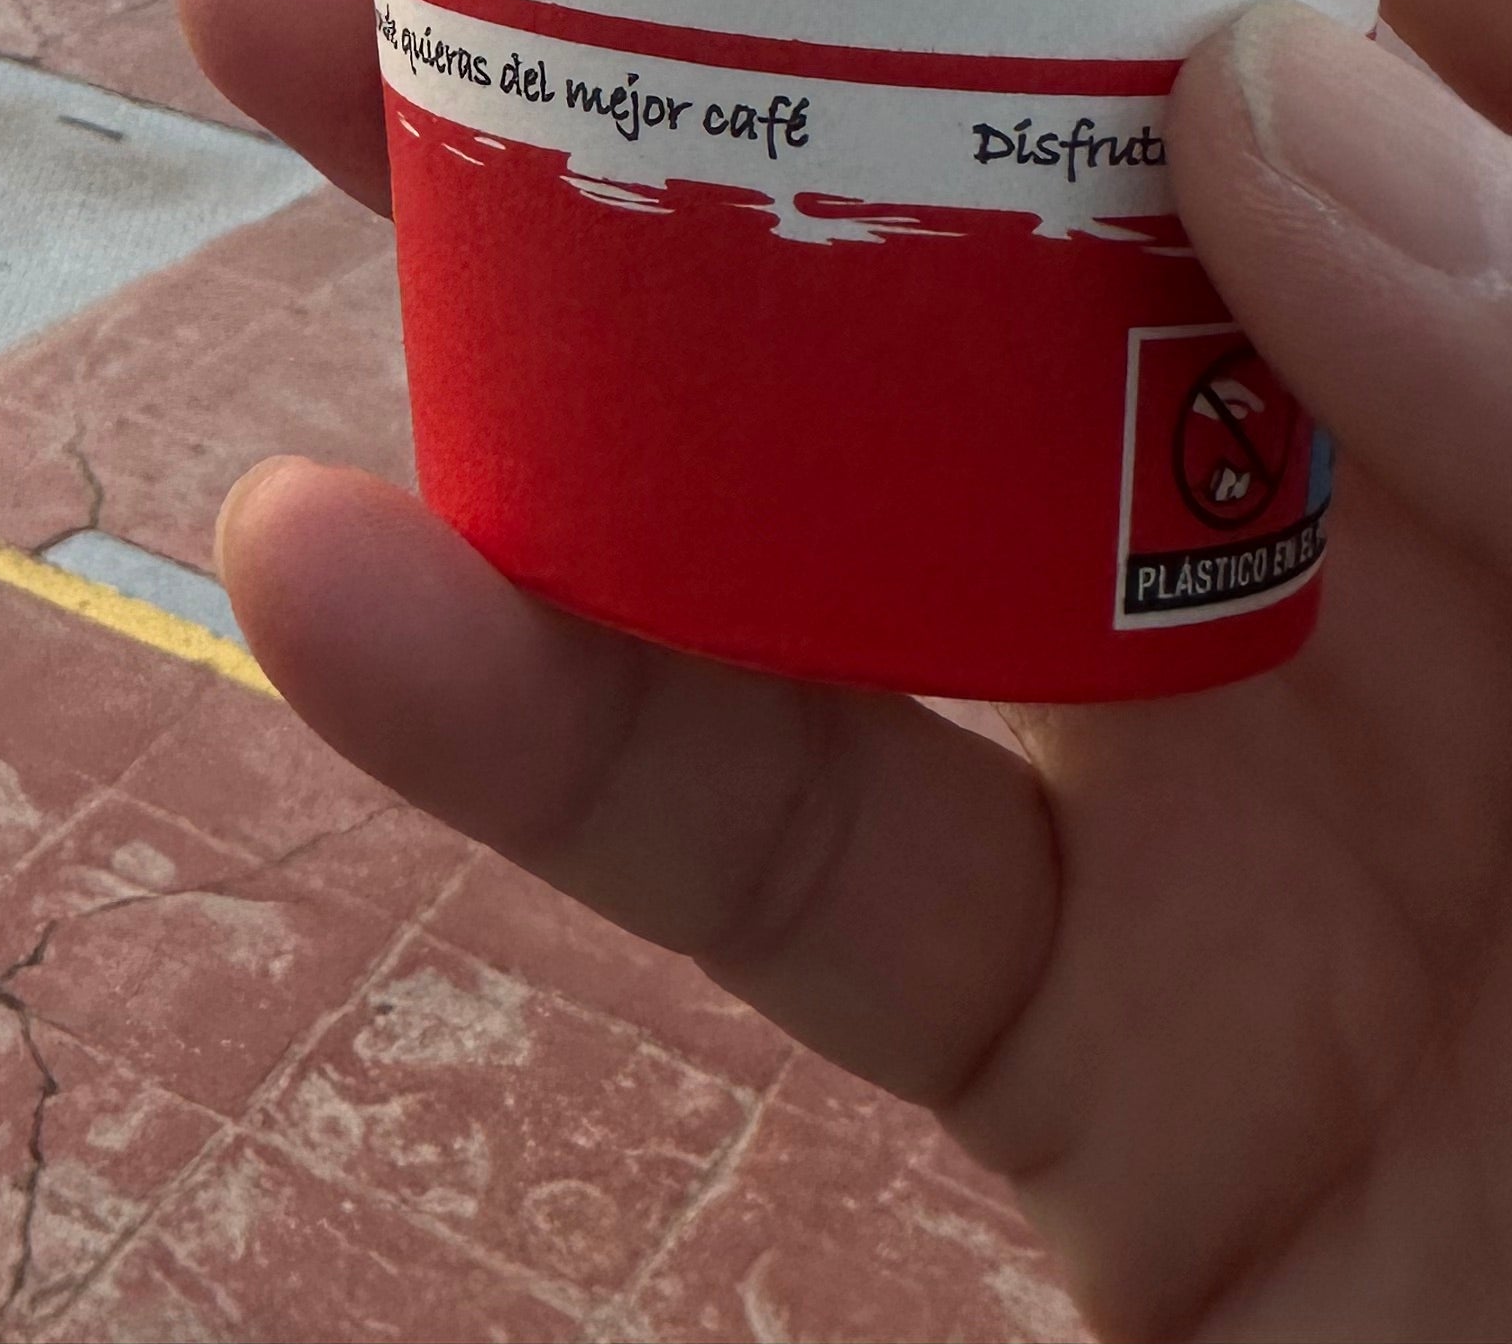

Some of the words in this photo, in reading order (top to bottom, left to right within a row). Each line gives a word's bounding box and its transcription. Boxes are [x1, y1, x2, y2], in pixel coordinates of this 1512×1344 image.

[401, 26, 491, 86] quieras
[500, 52, 555, 102] del
[566, 72, 693, 142] mejor
[702, 95, 811, 160] café
[972, 117, 1167, 183] Disfrut
[1137, 548, 1268, 601] PLÁSTICO
